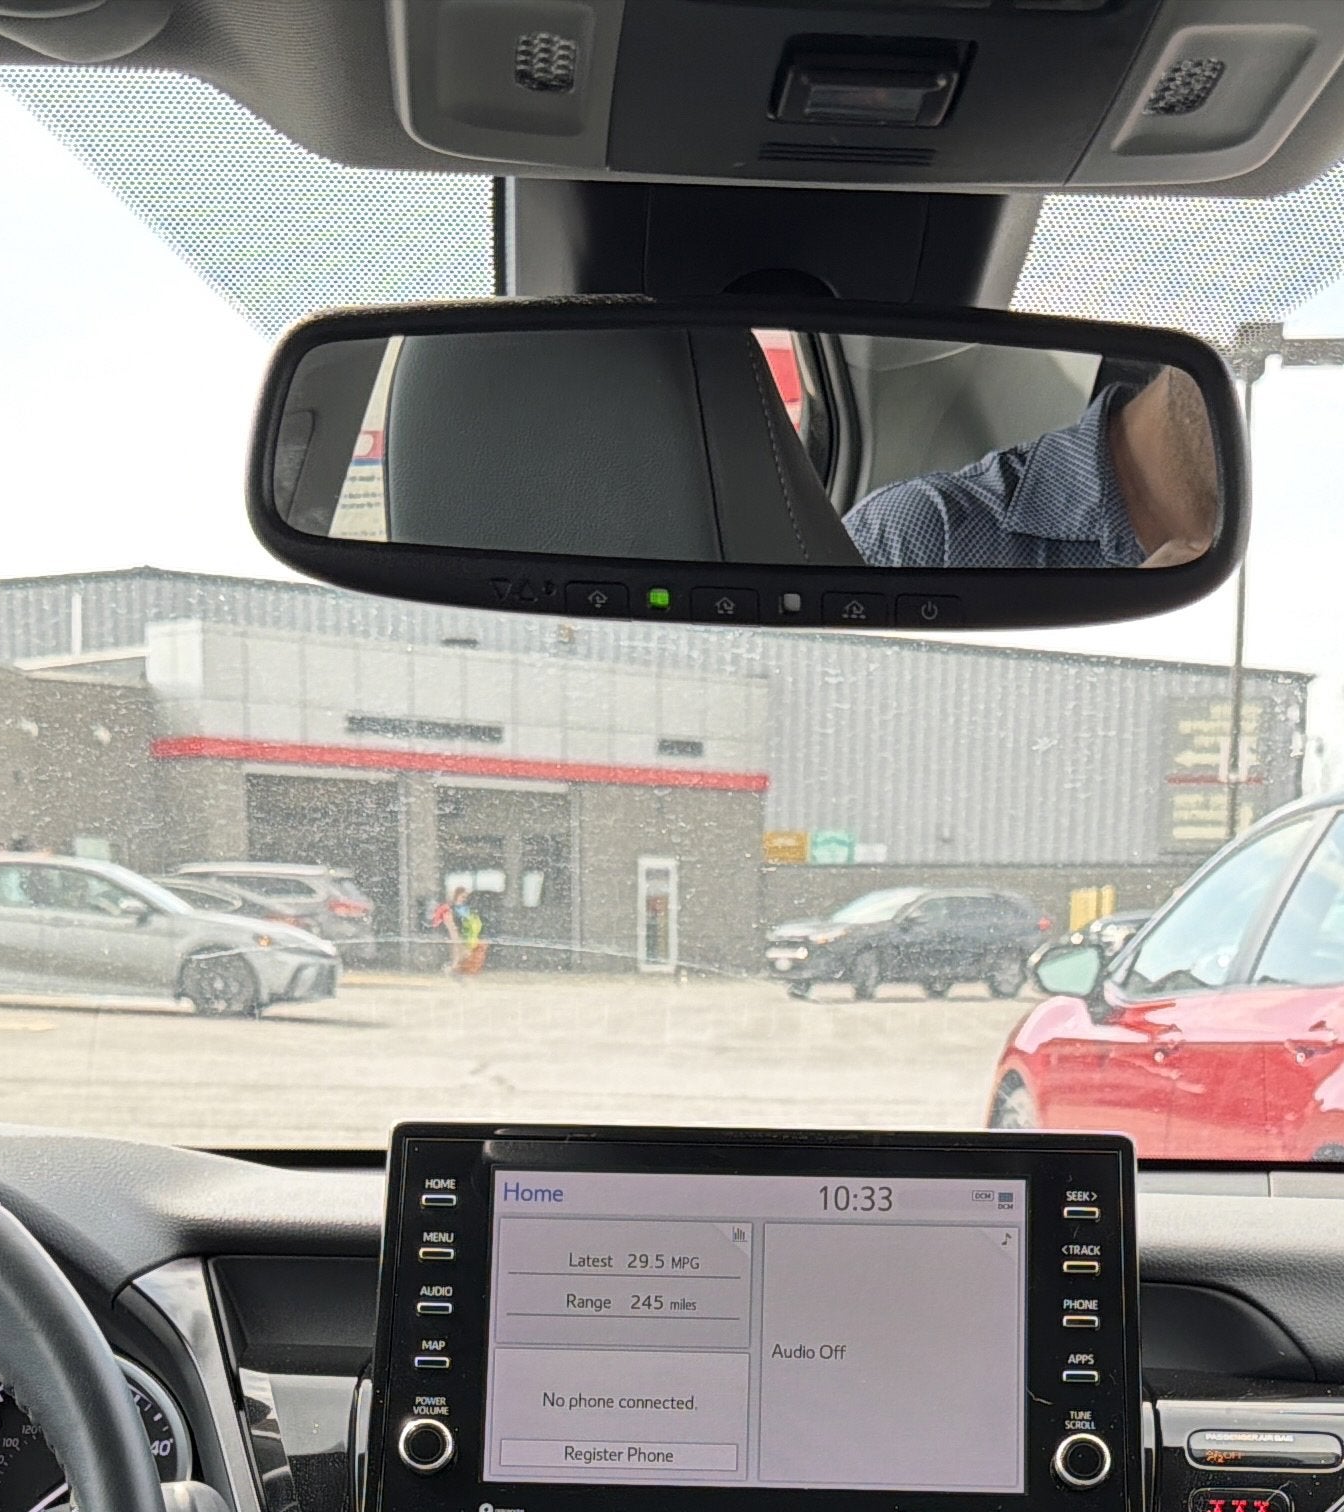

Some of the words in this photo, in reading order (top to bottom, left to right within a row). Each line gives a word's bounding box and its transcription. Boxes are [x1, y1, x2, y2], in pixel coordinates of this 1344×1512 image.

[424, 1179, 456, 1190] HOME
[503, 1182, 564, 1203] Home
[819, 1185, 894, 1212] 10:33
[422, 1232, 454, 1243] MENU
[568, 1252, 614, 1269] Latest
[627, 1253, 666, 1270] 29.5
[671, 1256, 700, 1270] MPG
[420, 1286, 453, 1297] AUDIO
[566, 1293, 612, 1312] Range
[630, 1295, 665, 1311] 245
[669, 1297, 697, 1312] miles
[1063, 1299, 1098, 1310] PHONE
[421, 1340, 446, 1351] MAP
[771, 1344, 816, 1360] Audio
[819, 1344, 848, 1360] Off
[1067, 1354, 1095, 1365] APPS
[415, 1396, 447, 1406] POWER
[543, 1392, 566, 1409] No
[568, 1393, 615, 1412] phone
[618, 1395, 698, 1412] connected.
[413, 1406, 449, 1416] VOLUME
[1069, 1411, 1092, 1420] TUNE
[21, 1424, 38, 1435] 120
[1064, 1420, 1097, 1430] SCROLL
[1205, 1432, 1257, 1441] PASSENGER
[1257, 1434, 1274, 1442] AIR
[1274, 1434, 1294, 1442] BAG
[2, 1438, 19, 1448] 100
[564, 1445, 624, 1465] Register
[627, 1447, 674, 1464] Phone
